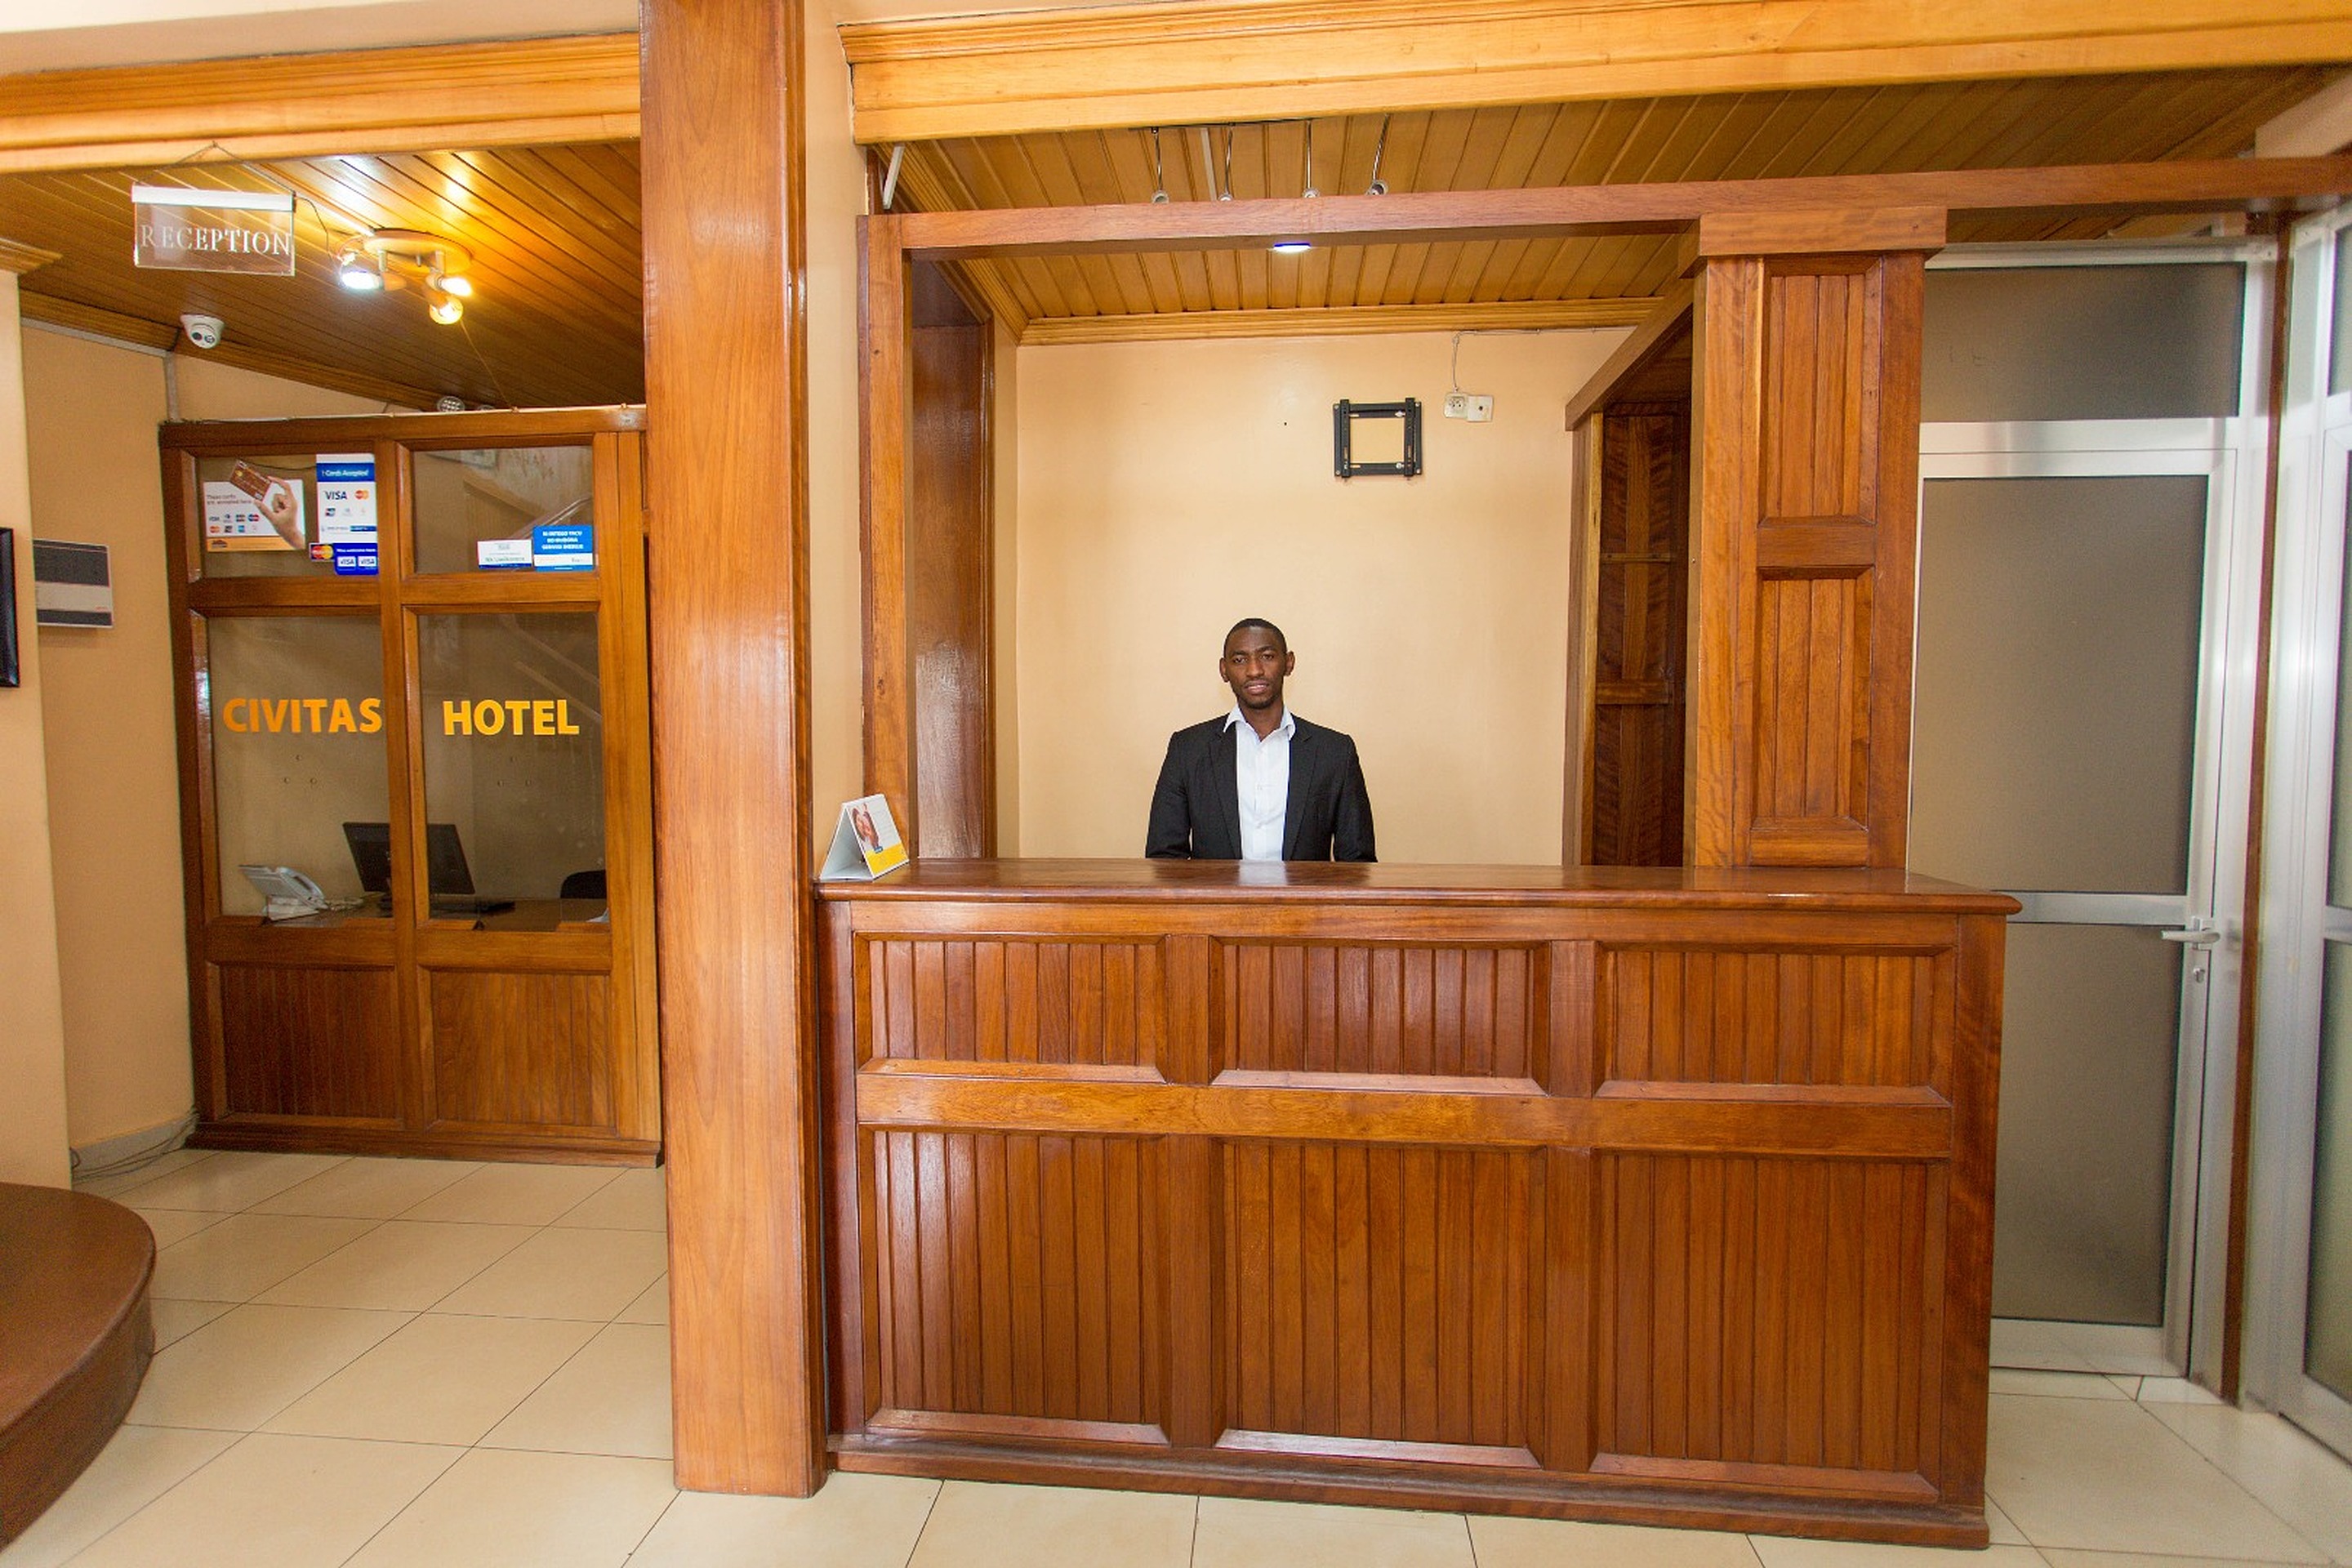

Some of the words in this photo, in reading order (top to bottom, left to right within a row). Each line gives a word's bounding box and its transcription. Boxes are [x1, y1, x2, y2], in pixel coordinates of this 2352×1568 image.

[141, 224, 292, 256] RECEPTION
[324, 490, 347, 500] VISA
[222, 697, 383, 733] CIVITAS
[443, 699, 580, 735] HOTEL
